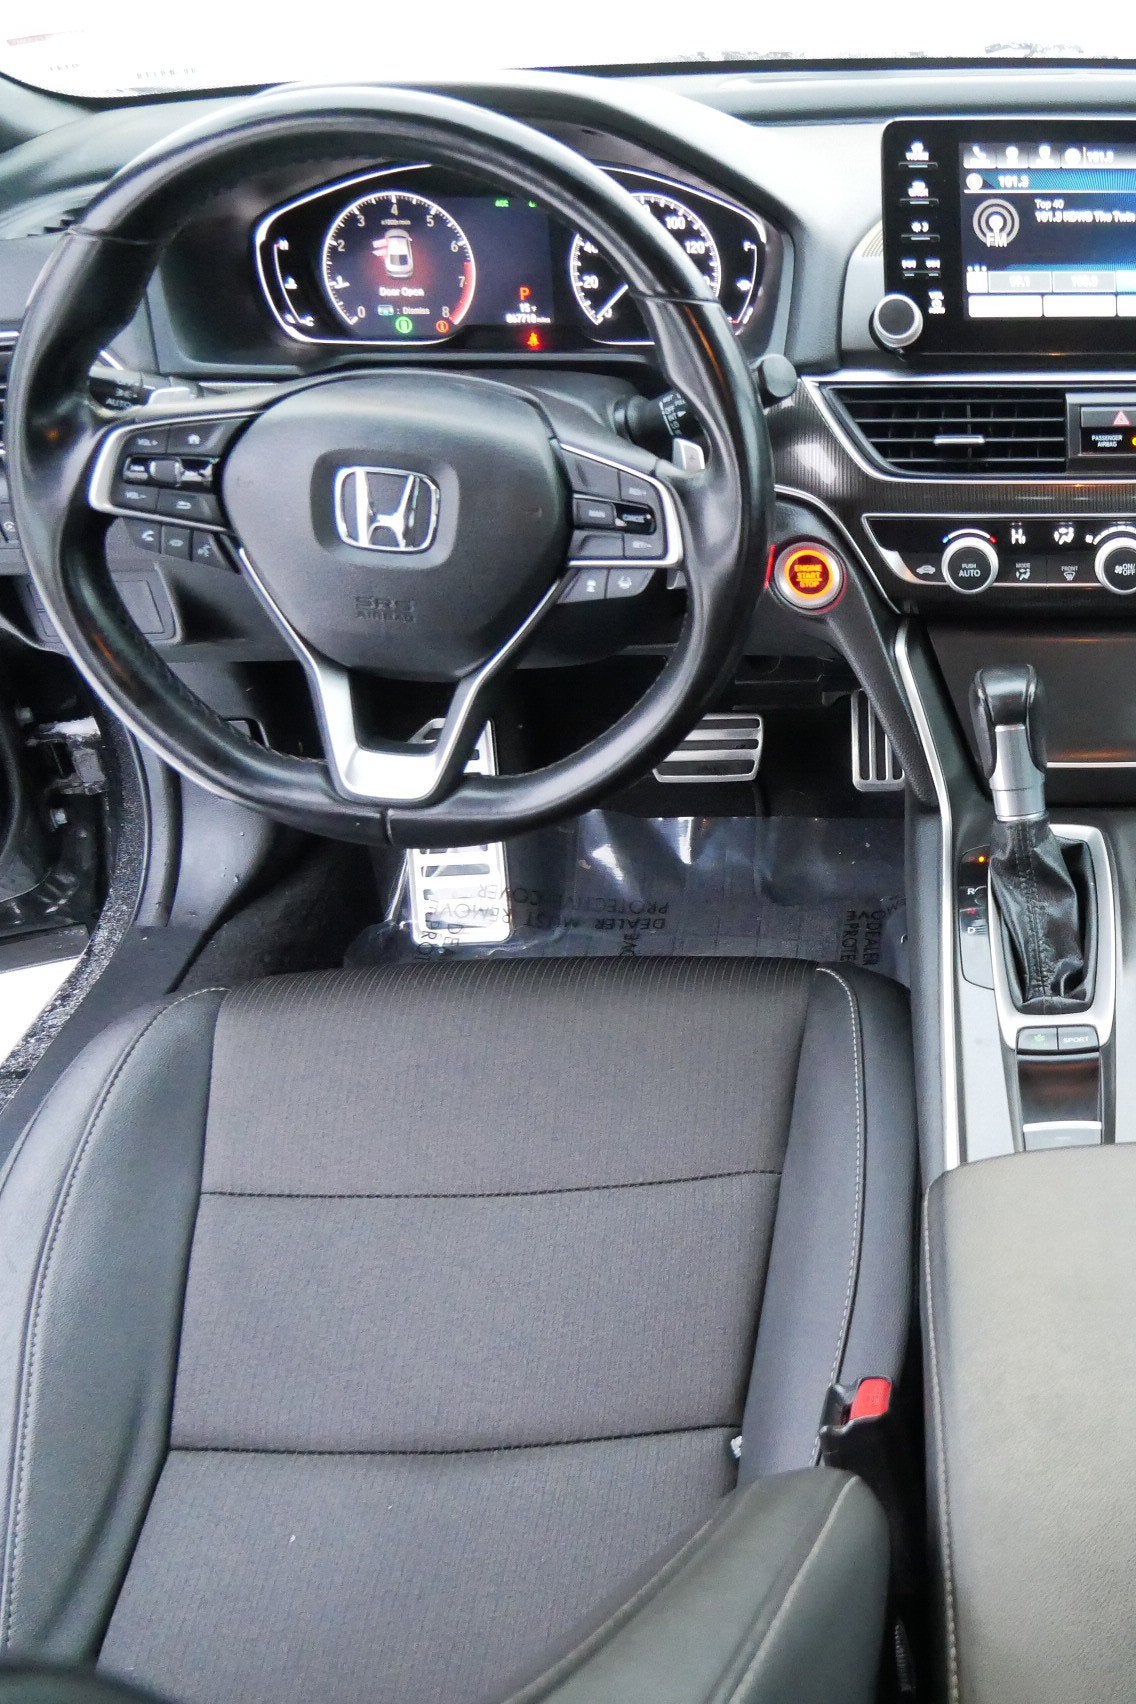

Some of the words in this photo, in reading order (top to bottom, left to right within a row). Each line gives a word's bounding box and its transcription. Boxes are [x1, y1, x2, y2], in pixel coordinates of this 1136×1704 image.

[390, 203, 399, 215] 4
[1035, 199, 1052, 210] Top
[357, 215, 366, 227] 3
[426, 215, 434, 227] 5
[665, 217, 686, 230] 100
[337, 240, 345, 252] 2
[450, 241, 459, 252] 6
[685, 240, 705, 254] 120
[458, 277, 466, 288] 7
[583, 275, 599, 289] 20
[519, 286, 531, 301] P
[357, 306, 366, 318] 0
[441, 306, 450, 318] 8
[794, 564, 823, 572] ENGINE
[958, 569, 981, 578] AUTO
[796, 571, 821, 579] START
[800, 580, 820, 588] STOP
[967, 887, 975, 895] R
[967, 926, 976, 934] D
[1063, 1036, 1089, 1044] SPORT
